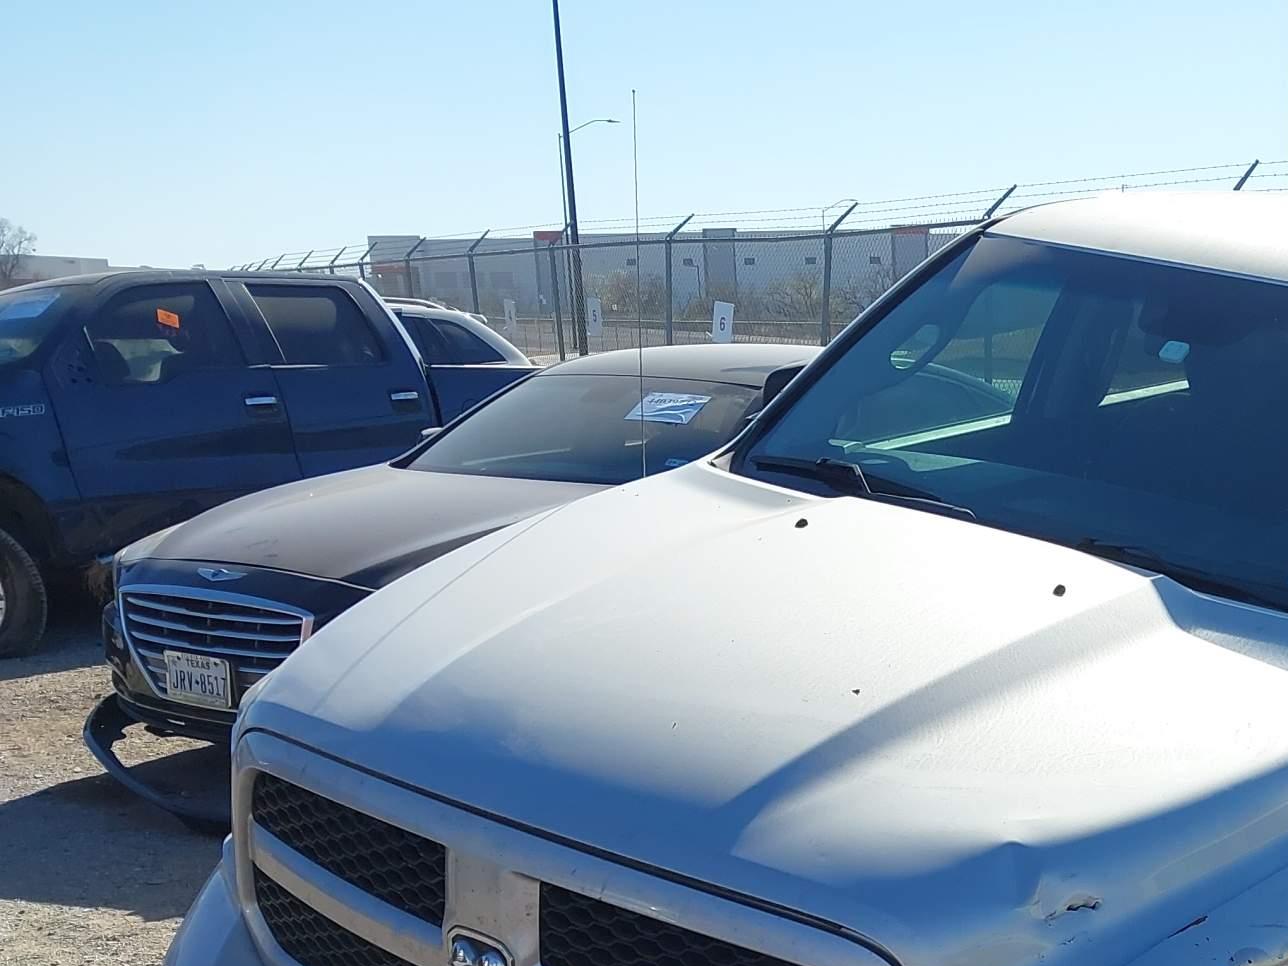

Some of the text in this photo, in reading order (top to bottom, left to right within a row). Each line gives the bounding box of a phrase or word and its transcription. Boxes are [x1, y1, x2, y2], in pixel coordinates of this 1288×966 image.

[591, 309, 598, 323] 5
[719, 316, 727, 332] 6
[186, 658, 211, 670] TEXAS
